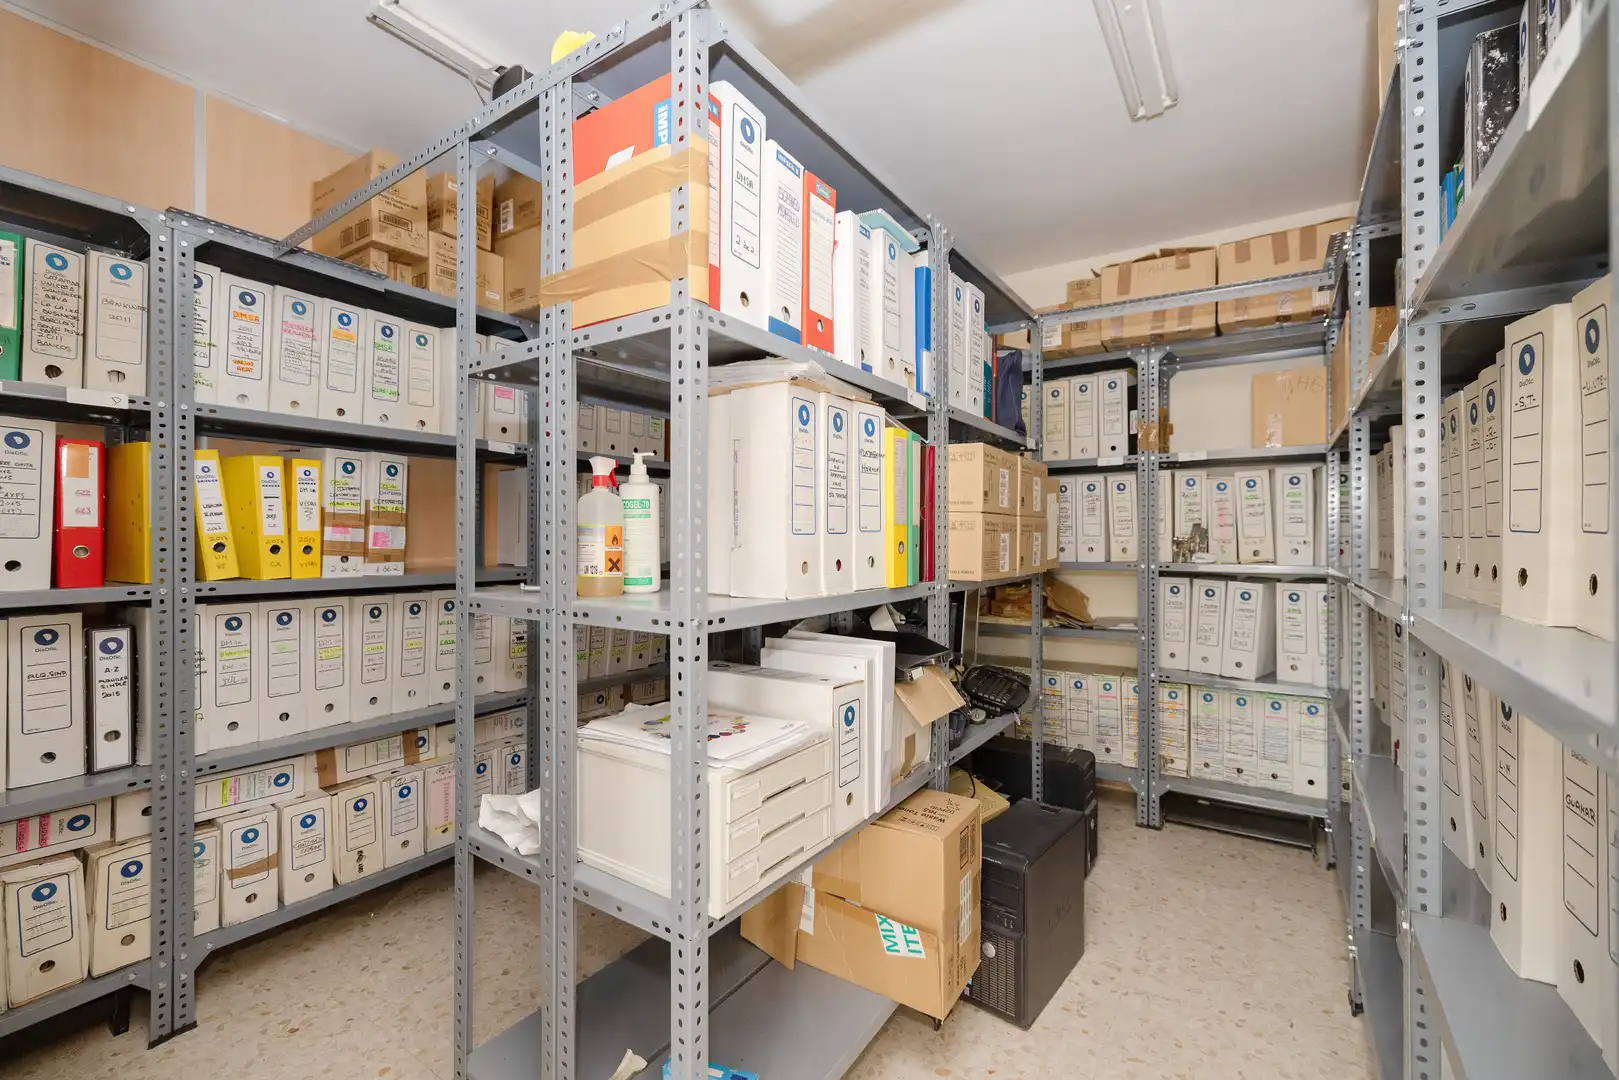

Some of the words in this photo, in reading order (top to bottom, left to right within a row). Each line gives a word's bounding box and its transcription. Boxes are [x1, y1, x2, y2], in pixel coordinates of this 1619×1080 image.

[101, 691, 121, 699] 2015
[920, 812, 946, 823] Waste
[876, 913, 901, 954] MIX
